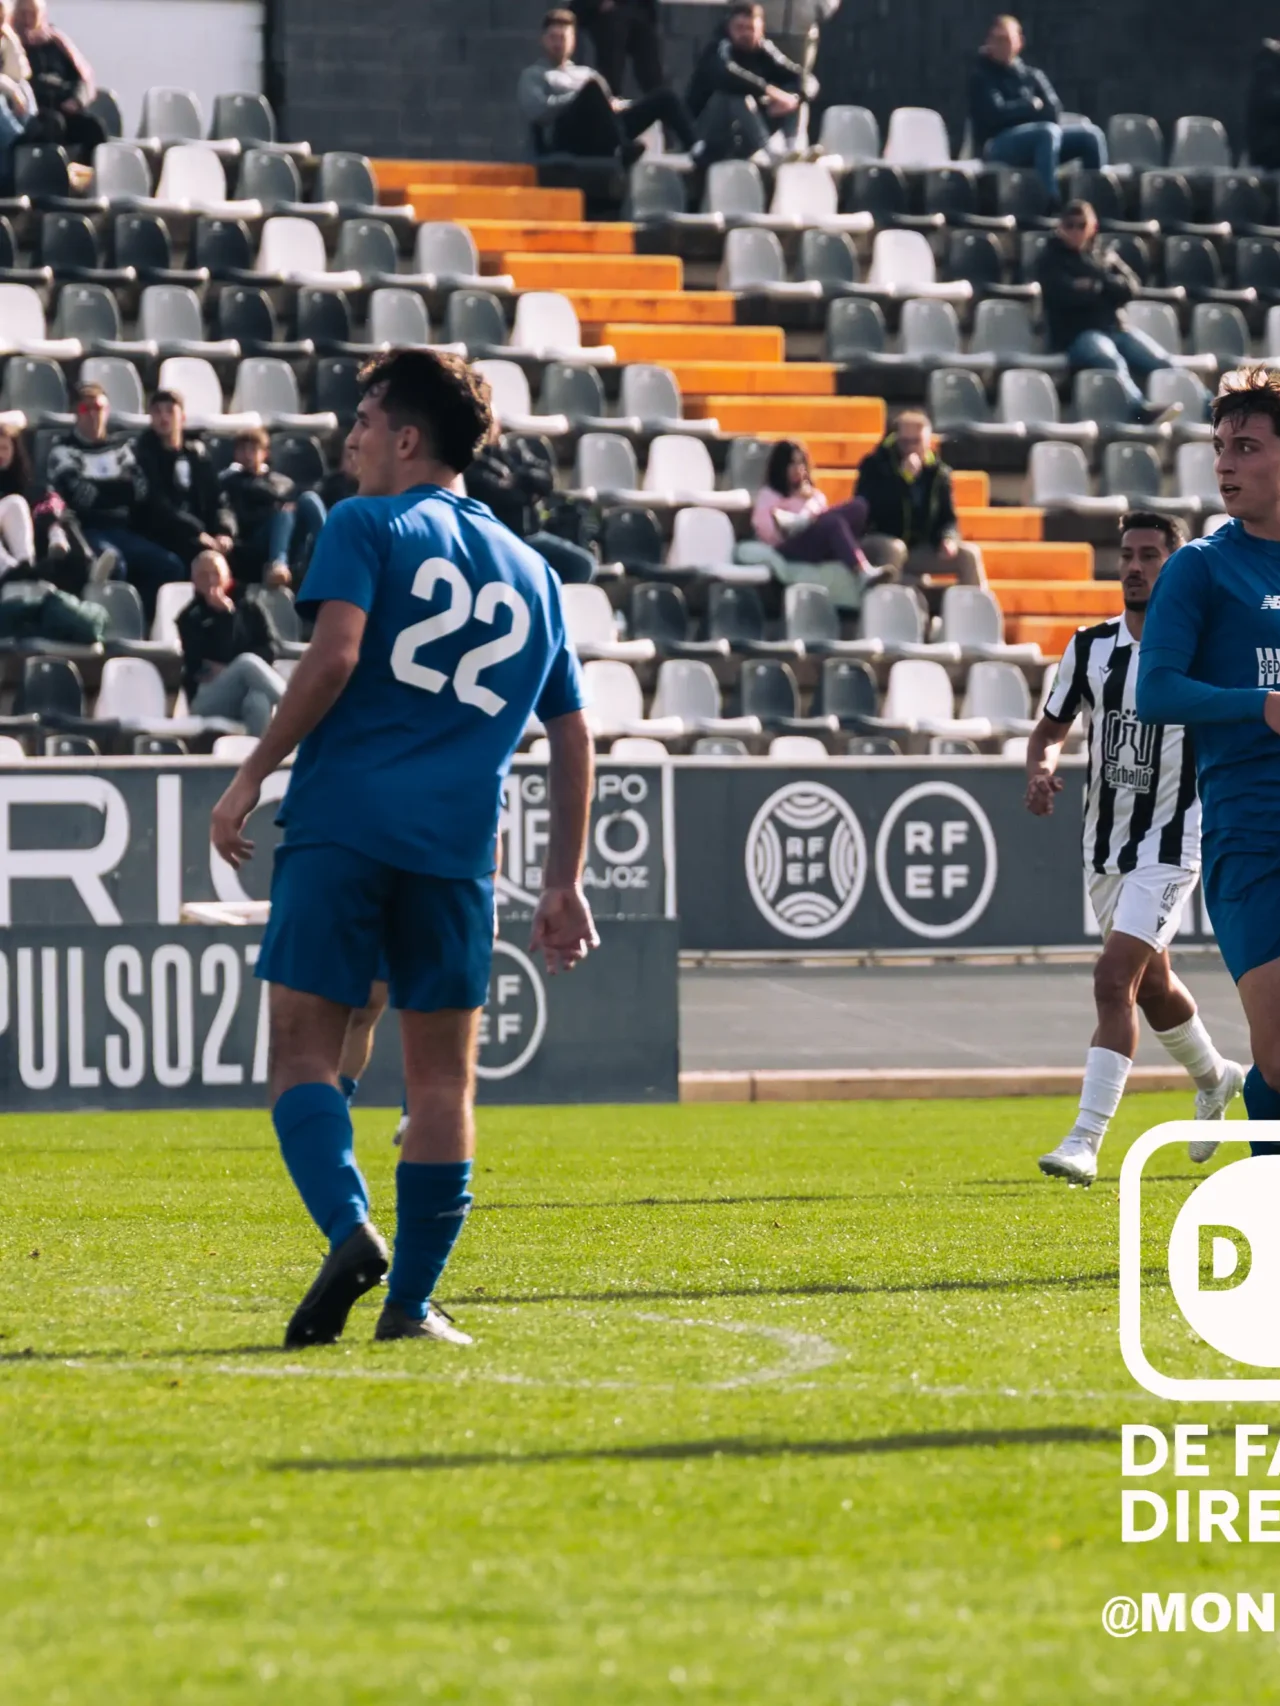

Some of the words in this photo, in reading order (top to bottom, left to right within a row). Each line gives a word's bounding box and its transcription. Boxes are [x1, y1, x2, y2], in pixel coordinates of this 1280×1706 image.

[390, 557, 531, 717] 22
[522, 773, 650, 805] GPO
[785, 836, 825, 859] RF
[904, 820, 969, 855] RF
[785, 862, 826, 885] EF
[904, 864, 970, 899] EF
